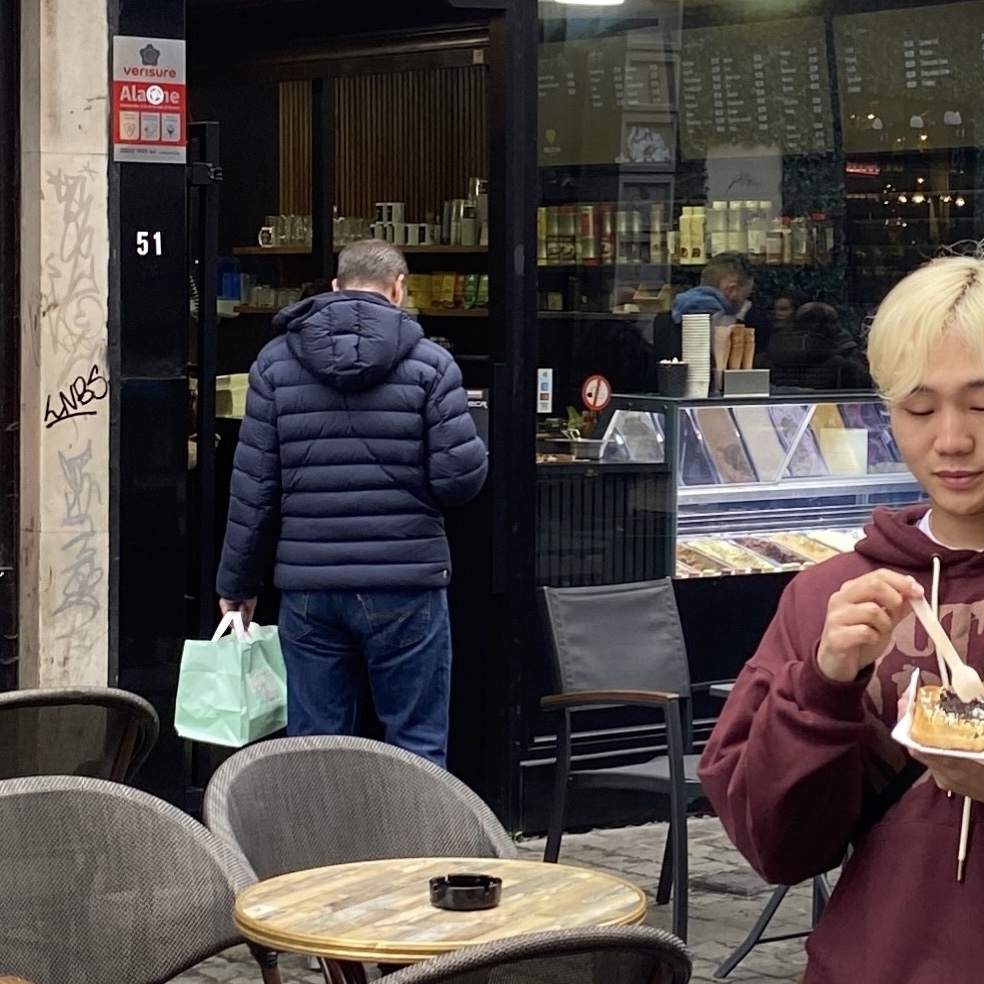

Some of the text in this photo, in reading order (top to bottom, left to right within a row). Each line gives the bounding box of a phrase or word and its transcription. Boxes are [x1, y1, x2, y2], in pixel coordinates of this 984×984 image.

[123, 66, 177, 78] verisure
[120, 85, 180, 104] Alae
[137, 231, 162, 256] 51
